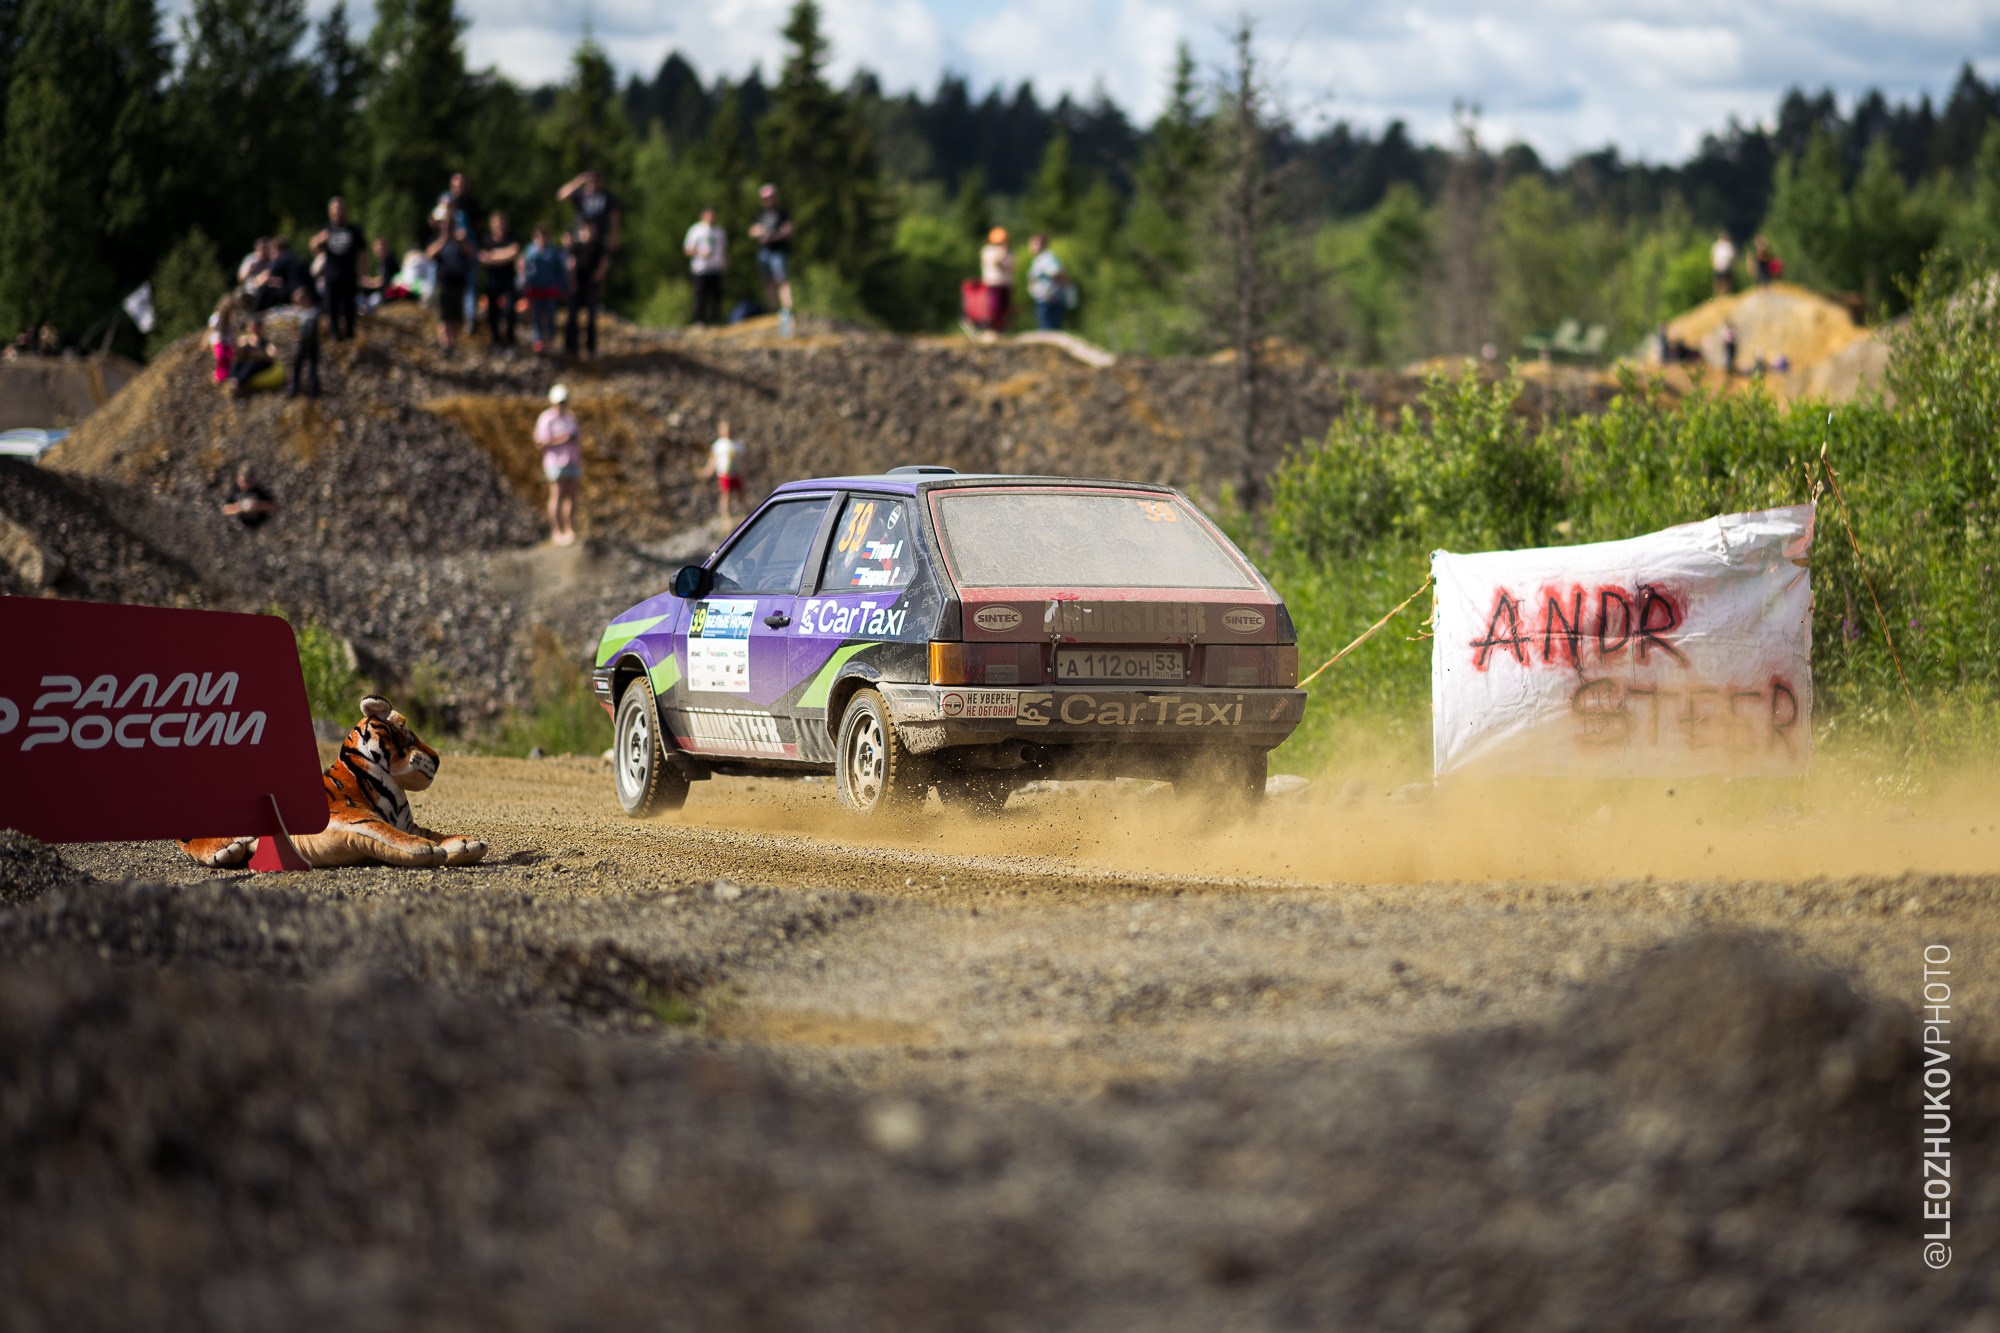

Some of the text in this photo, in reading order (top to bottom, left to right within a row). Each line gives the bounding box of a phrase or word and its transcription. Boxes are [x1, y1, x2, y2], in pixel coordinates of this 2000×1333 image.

[1136, 501, 1178, 523] 39
[838, 502, 874, 552] 39
[691, 608, 707, 632] 39
[818, 600, 909, 636] CarTaxi
[978, 614, 1019, 623] SINTEC
[1225, 616, 1262, 625] SINTEC
[1469, 580, 1691, 668] ANDR
[1155, 655, 1176, 671] 53
[33, 672, 239, 710] РАЛЛИ
[967, 693, 978, 704] НЕ
[966, 704, 1016, 717] НЕ ОБГОНЯЙ!
[1060, 694, 1244, 726] CarTaxi
[20, 711, 266, 751] РОССИИ
